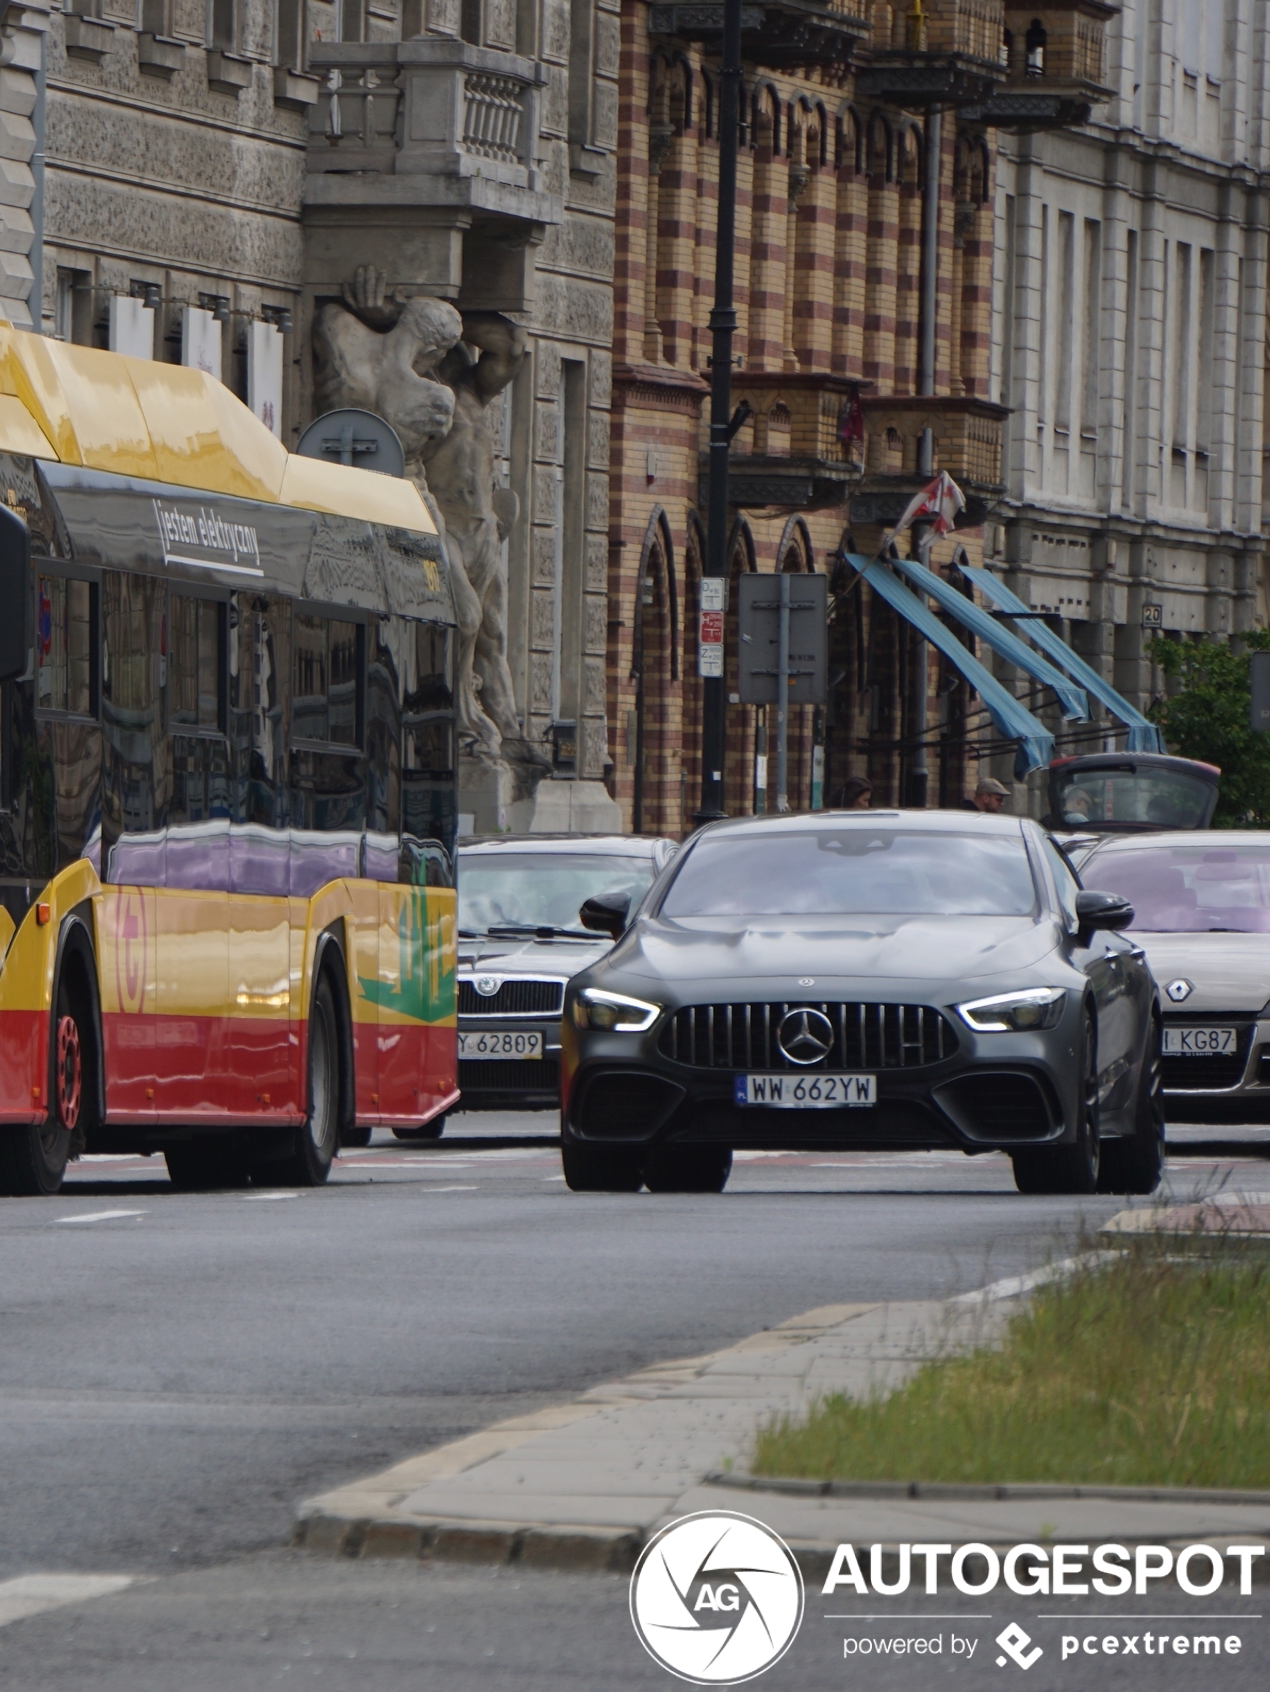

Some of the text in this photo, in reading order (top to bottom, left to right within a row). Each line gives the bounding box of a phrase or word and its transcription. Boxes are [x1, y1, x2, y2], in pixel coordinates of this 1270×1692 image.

[157, 500, 261, 566] jestem elektryczny
[1145, 608, 1160, 621] 20
[477, 1034, 539, 1054] 62809
[1180, 1030, 1233, 1050] KG87
[737, 1092, 747, 1100] PL
[752, 1077, 870, 1101] WW 662YW
